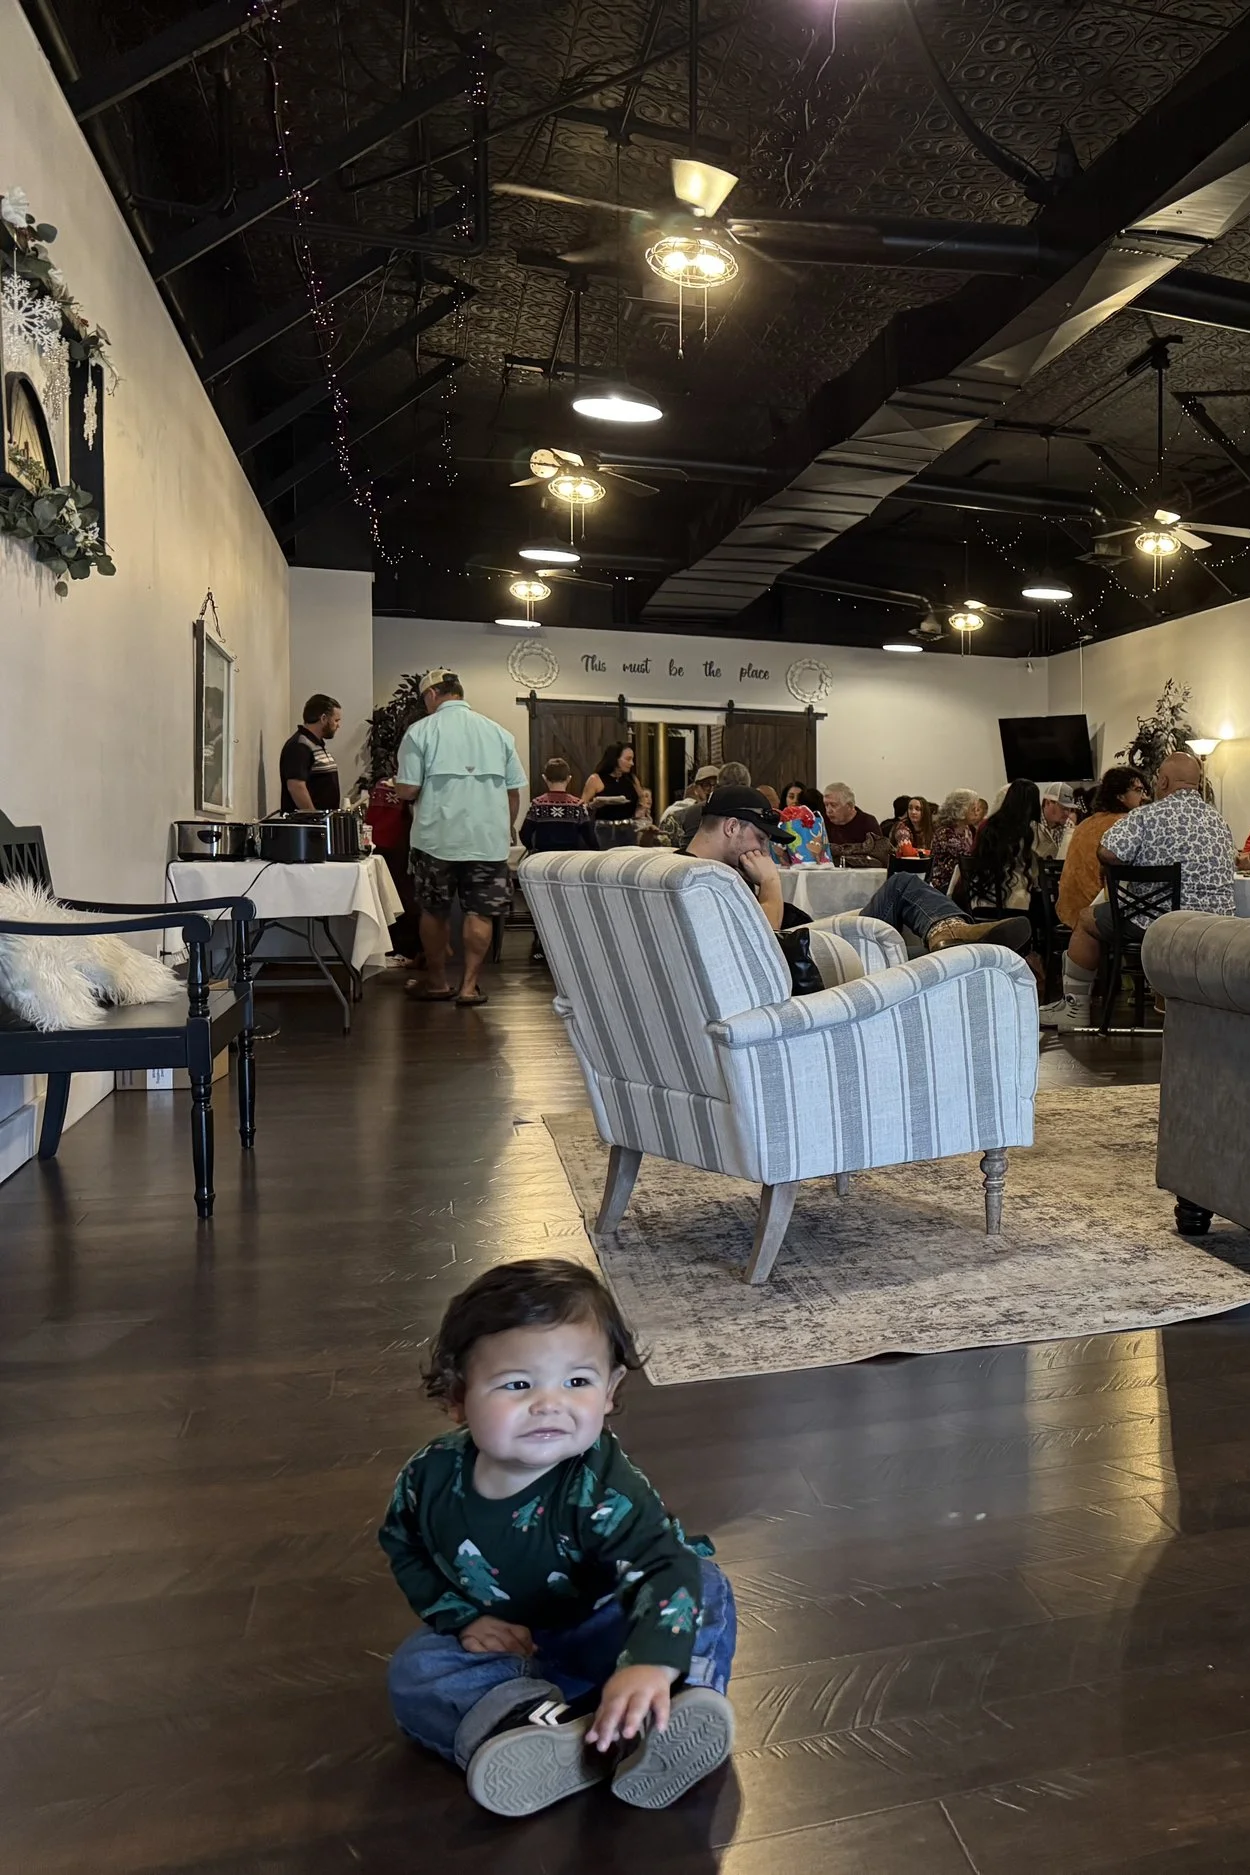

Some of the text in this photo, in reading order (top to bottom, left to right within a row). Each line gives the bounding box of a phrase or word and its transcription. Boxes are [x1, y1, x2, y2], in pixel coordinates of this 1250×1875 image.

[581, 655, 770, 683] This must be the place
